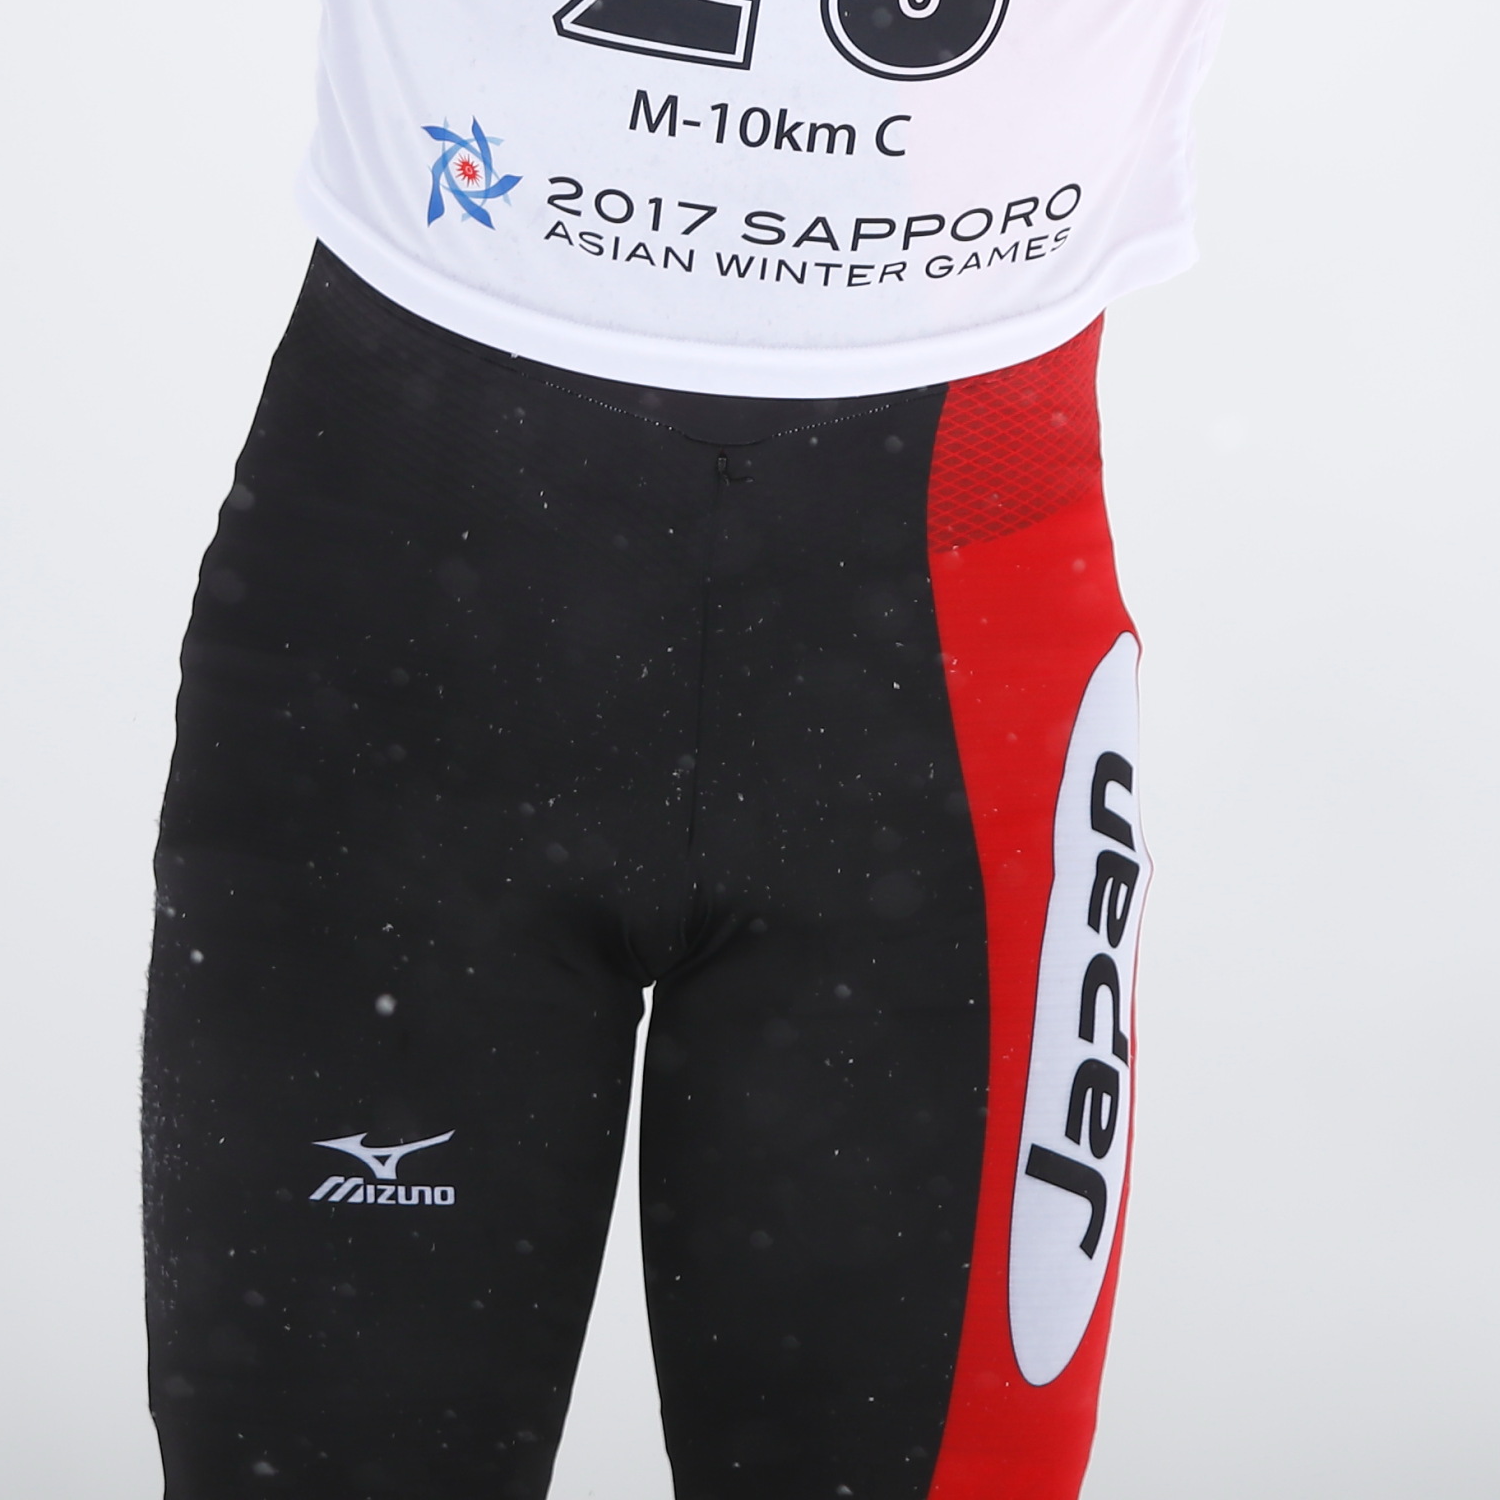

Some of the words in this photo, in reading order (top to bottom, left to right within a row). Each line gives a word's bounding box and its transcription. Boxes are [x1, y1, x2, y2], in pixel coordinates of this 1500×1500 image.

[628, 88, 857, 157] M-10km
[875, 114, 912, 157] C
[545, 176, 719, 237] 2017
[740, 183, 1083, 254] SAPPORO
[543, 220, 696, 273] ASIAN
[714, 251, 908, 288] WINTER
[924, 227, 1072, 280] GAMES
[1024, 751, 1141, 1261] Japan
[308, 1175, 456, 1206] MIZUNO
